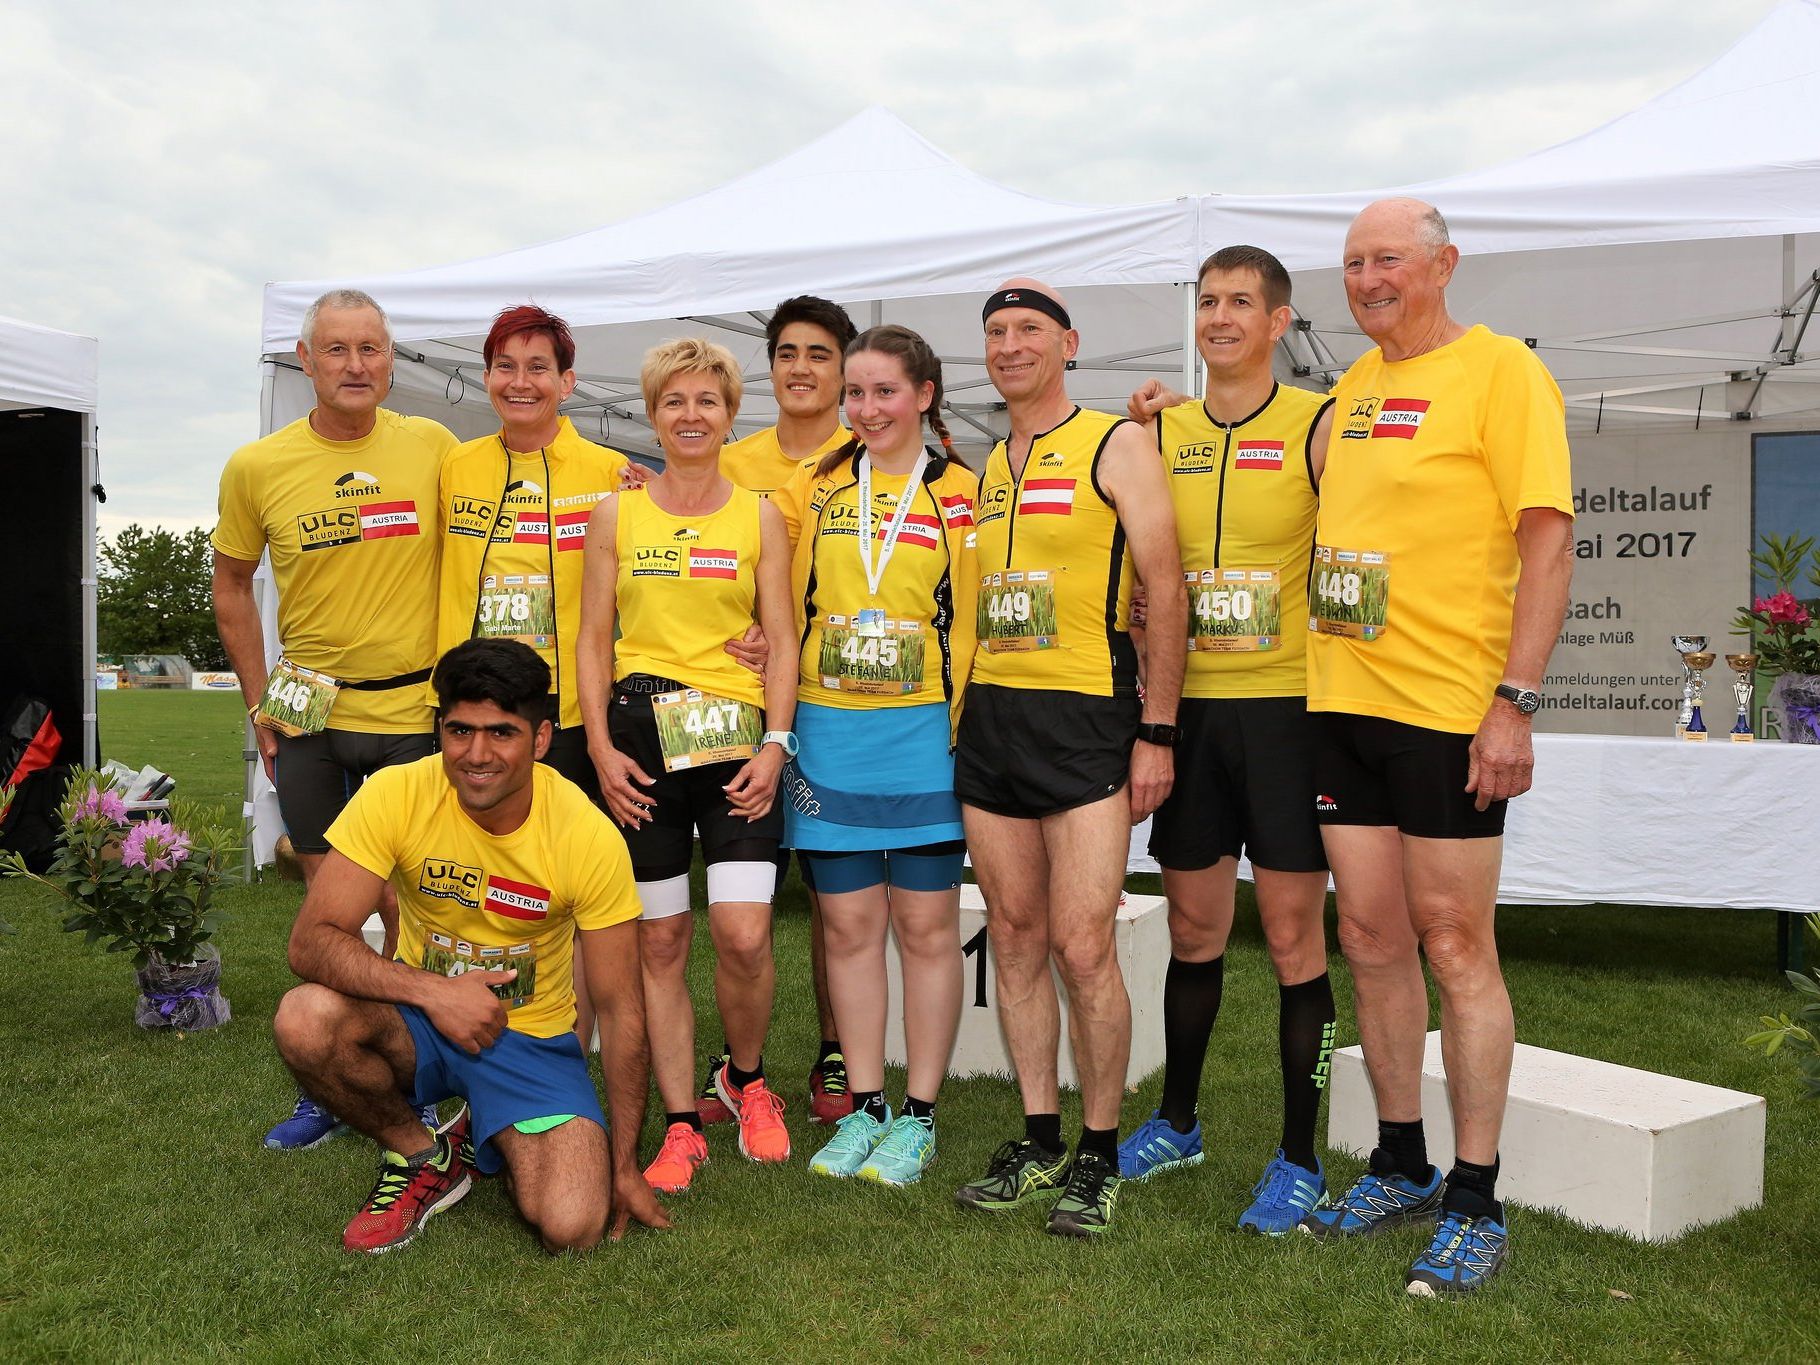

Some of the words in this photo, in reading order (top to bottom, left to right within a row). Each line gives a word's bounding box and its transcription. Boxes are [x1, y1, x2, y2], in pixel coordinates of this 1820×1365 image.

[1380, 413, 1418, 423] AUSTRIA
[1180, 446, 1213, 459] ULC
[1239, 450, 1279, 458] AUSTRIA
[335, 485, 381, 498] skinfit
[502, 494, 543, 504] skinfit
[874, 498, 898, 507] skinfit
[453, 501, 491, 520] ULC
[301, 512, 355, 533] ULC
[372, 514, 408, 525] AUSTRIA
[454, 517, 482, 528] BLUDENZ
[830, 520, 859, 528] BLUDE
[520, 523, 549, 532] AUST
[902, 524, 926, 533] STRIA
[309, 528, 351, 541] BLUDENZ
[1576, 534, 1602, 559] ai
[1616, 532, 1696, 558] 2017
[636, 549, 679, 561] ULC
[693, 559, 734, 567] AUSTRIA
[1318, 571, 1360, 606] 448
[479, 594, 529, 623] 378
[988, 591, 1030, 623] 449
[1195, 590, 1252, 621] 450
[1320, 603, 1353, 618] EDWIN
[484, 625, 500, 633] Gabi
[501, 624, 521, 632] Marte
[991, 624, 1026, 636] HUBERT
[1199, 623, 1245, 635] MARKUS
[1600, 631, 1634, 644] Müß
[841, 636, 898, 667] 445
[838, 663, 892, 678] STEFANIE
[1641, 675, 1680, 686] unter
[267, 676, 311, 712] 446
[685, 704, 739, 736] 447
[695, 733, 733, 750] IRENE
[427, 865, 478, 889] ULC
[430, 881, 471, 897] BLUDENZ
[490, 890, 544, 910] AUSTRIA
[961, 925, 988, 1008] 1
